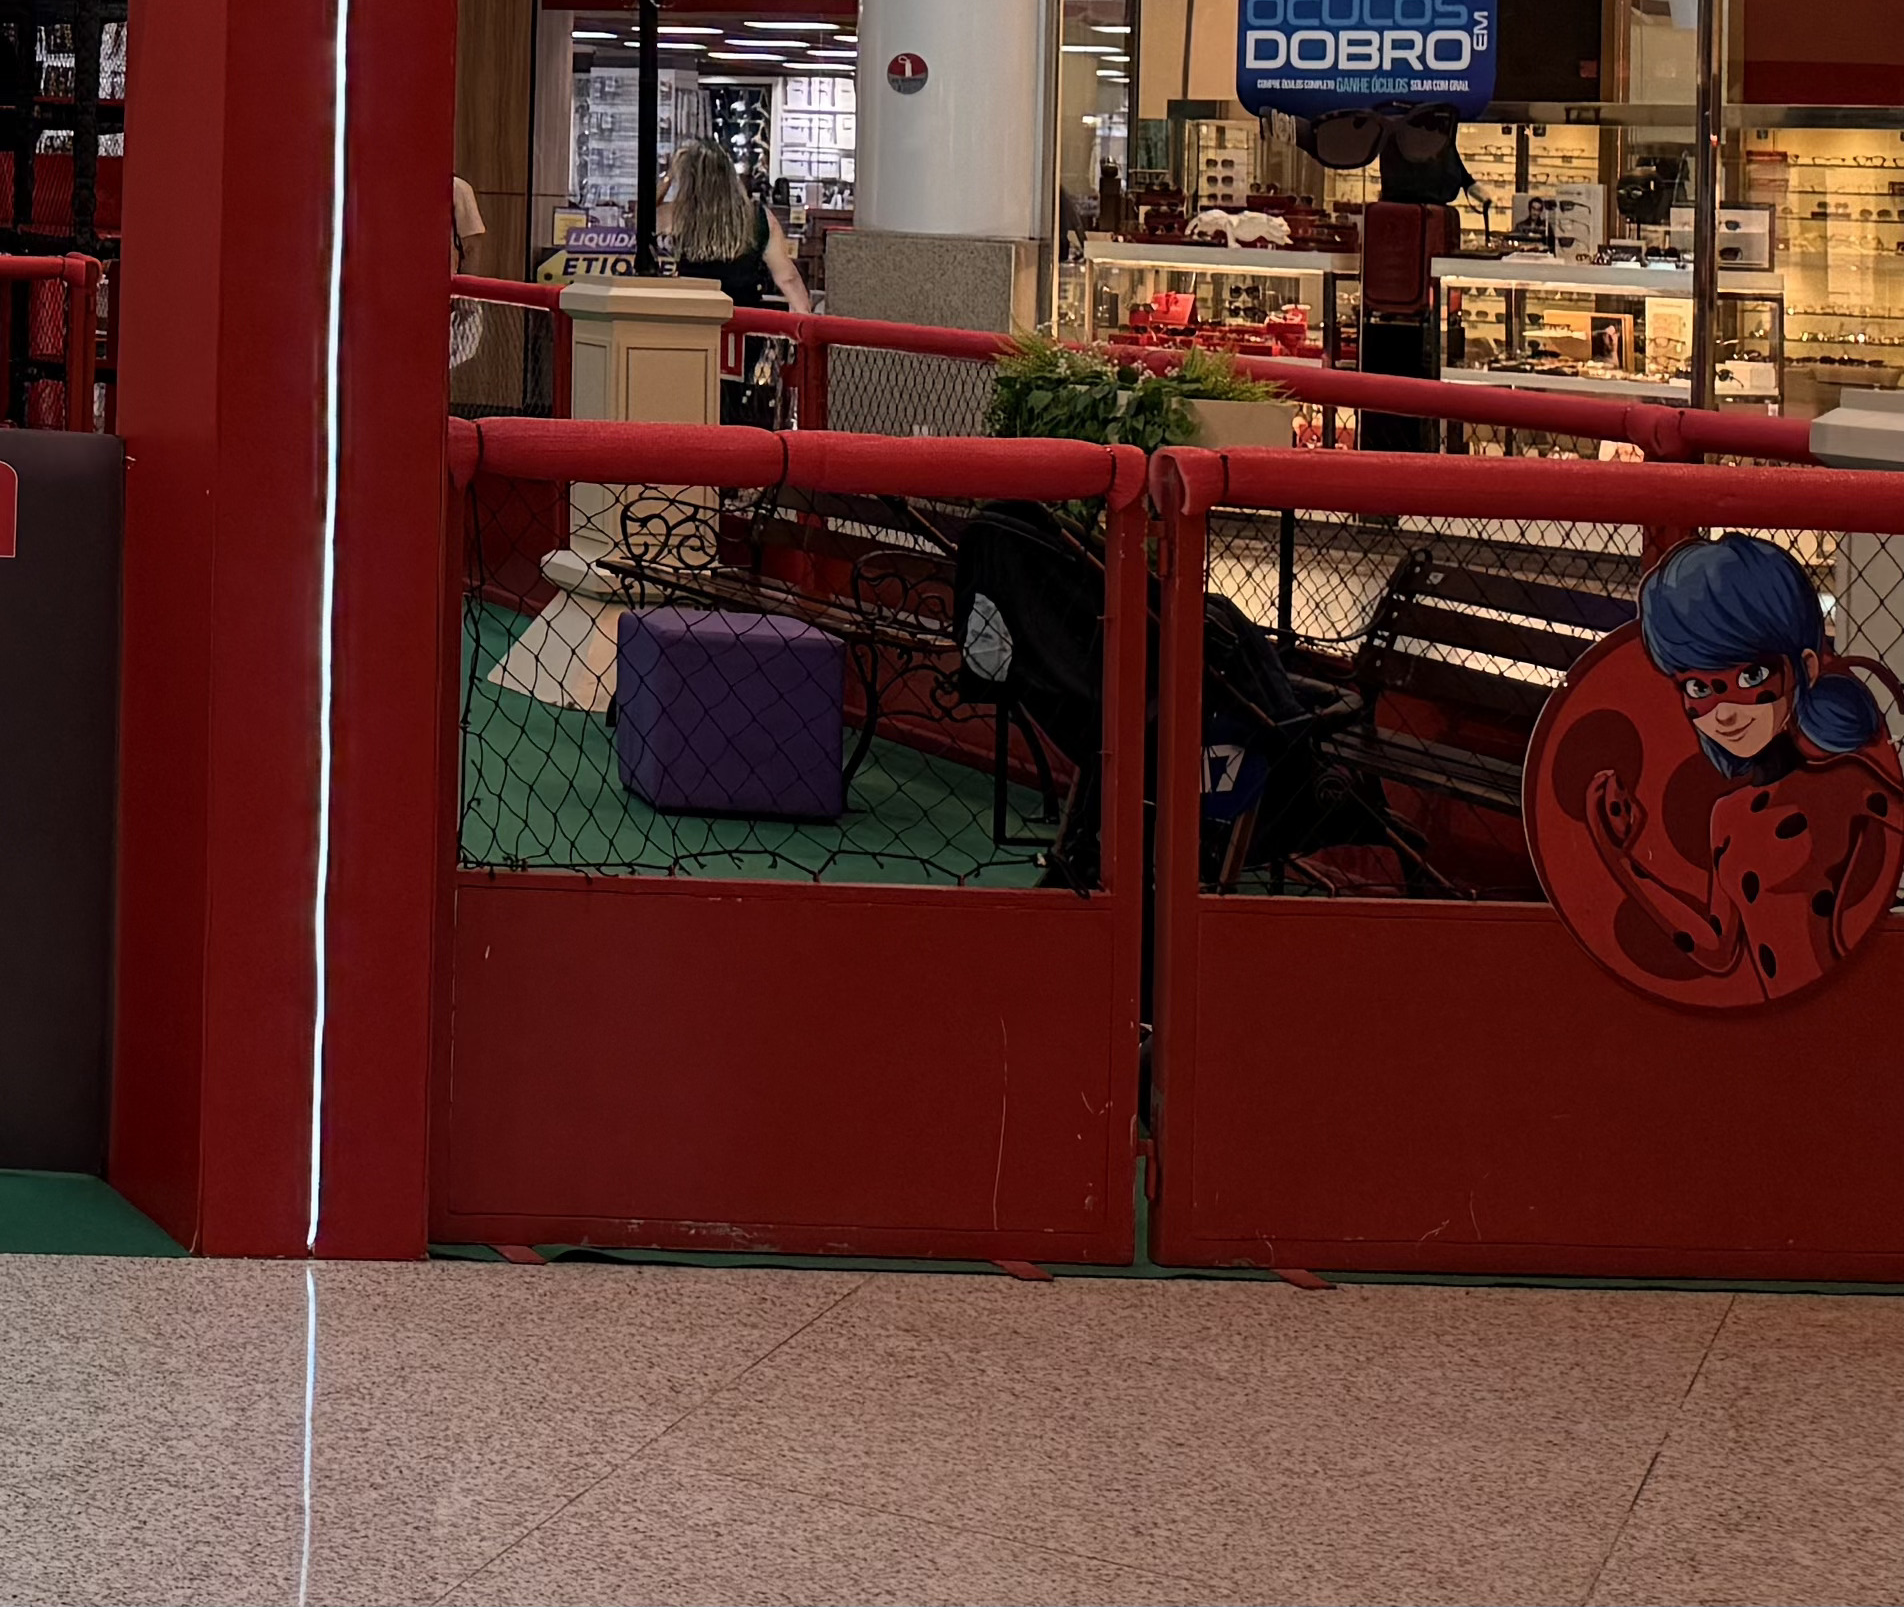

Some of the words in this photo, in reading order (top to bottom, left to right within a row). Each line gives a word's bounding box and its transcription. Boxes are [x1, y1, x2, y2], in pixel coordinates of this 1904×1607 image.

[1245, 30, 1471, 71] DOBRO
[1336, 78, 1371, 93] GANHE
[1371, 75, 1409, 93] ÓCULOS
